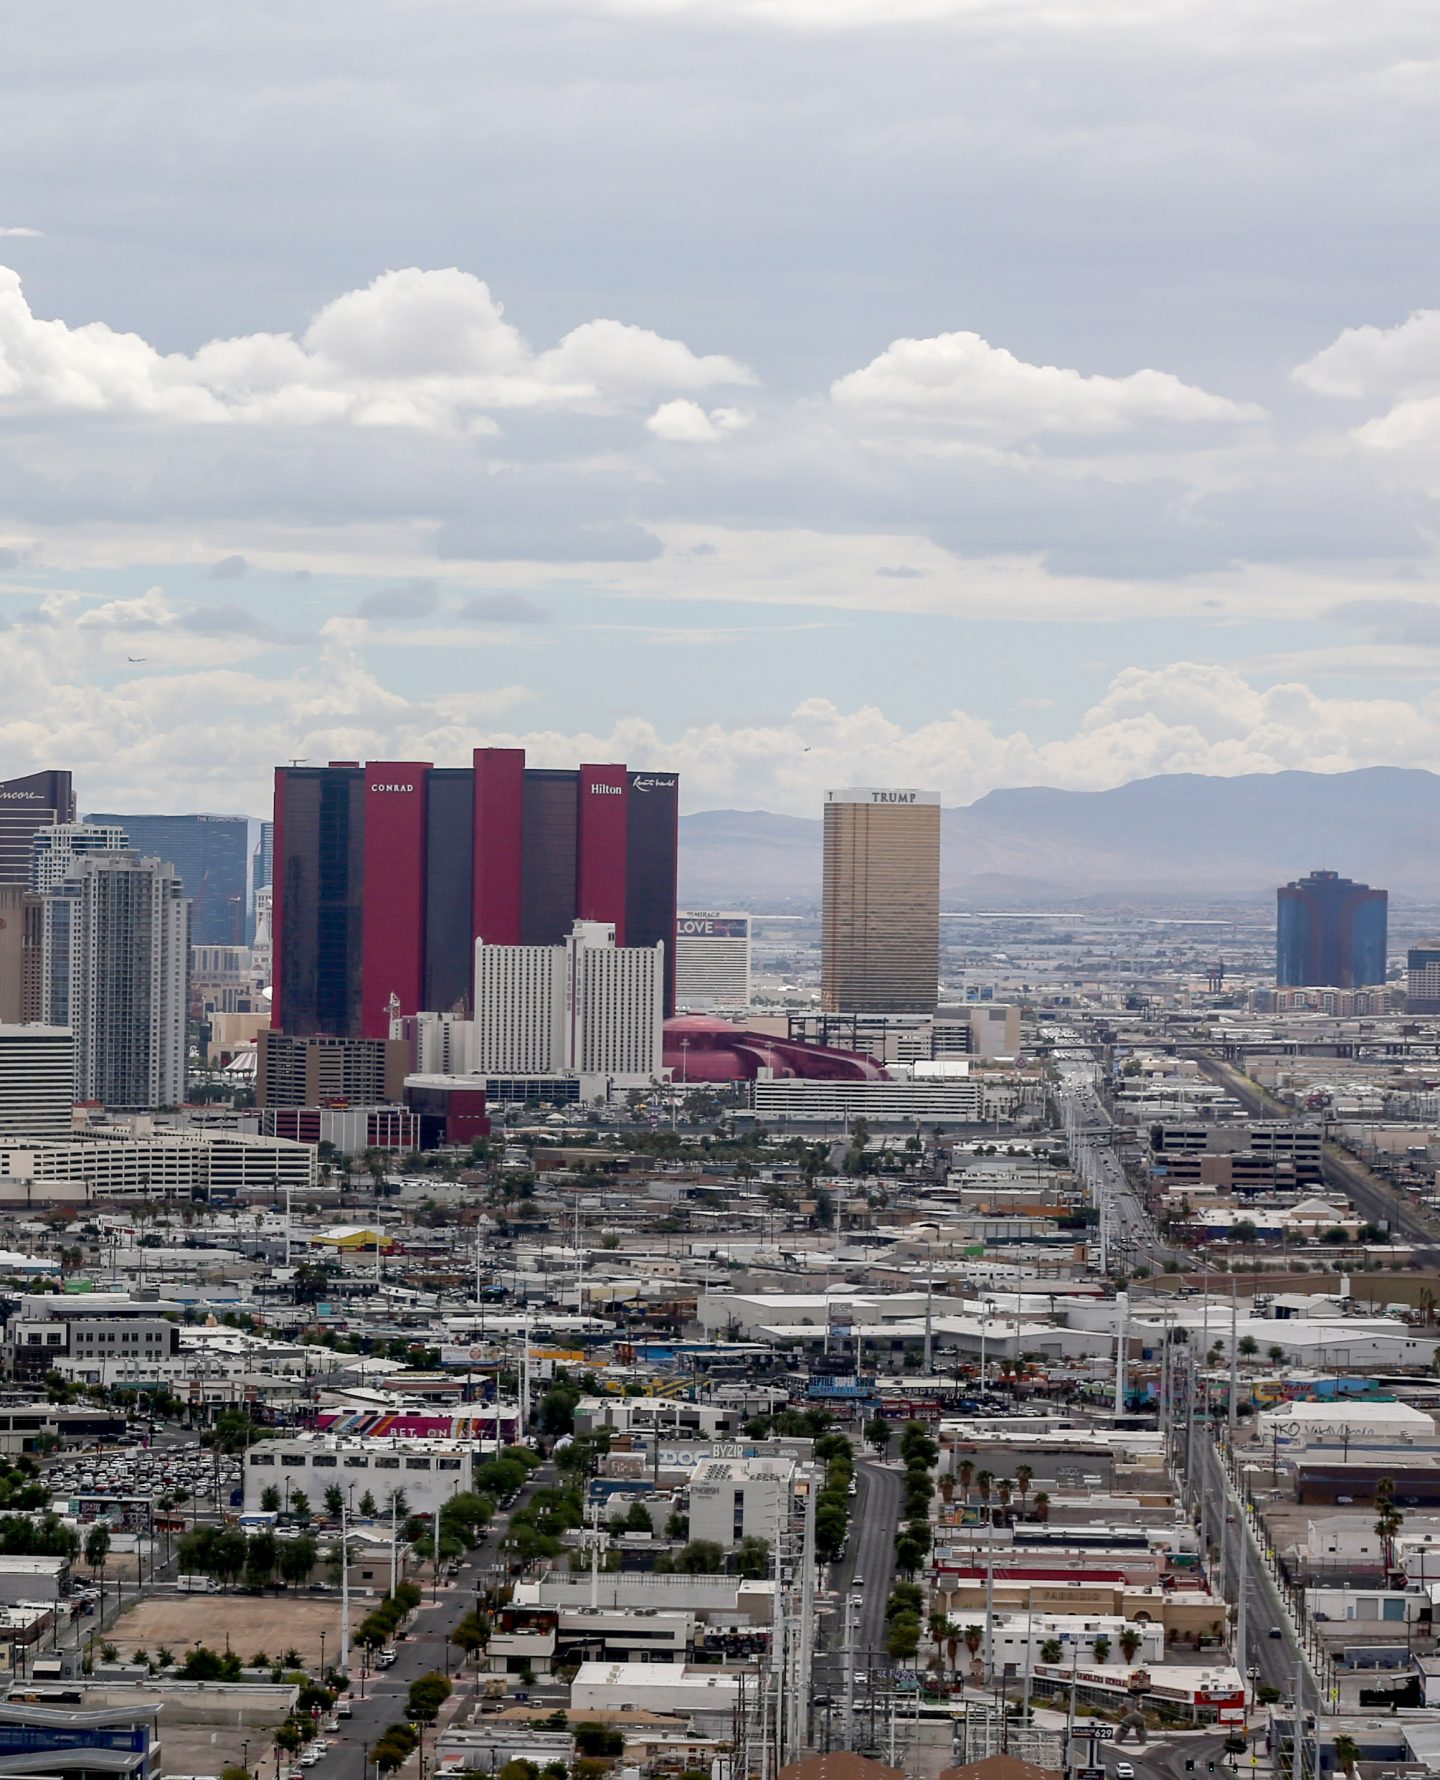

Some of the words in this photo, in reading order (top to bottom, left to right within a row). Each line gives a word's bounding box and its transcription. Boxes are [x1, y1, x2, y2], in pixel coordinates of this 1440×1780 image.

[371, 784, 414, 792] CONRAD
[591, 783, 622, 795] Hilton
[871, 792, 916, 803] TRUMP
[677, 921, 713, 934] LOVE
[809, 1376, 834, 1387] REPTILE
[834, 1376, 855, 1387] SUPER
[856, 1376, 875, 1387] SHOW
[427, 1429, 447, 1437] ON
[1095, 1729, 1112, 1738] 629
